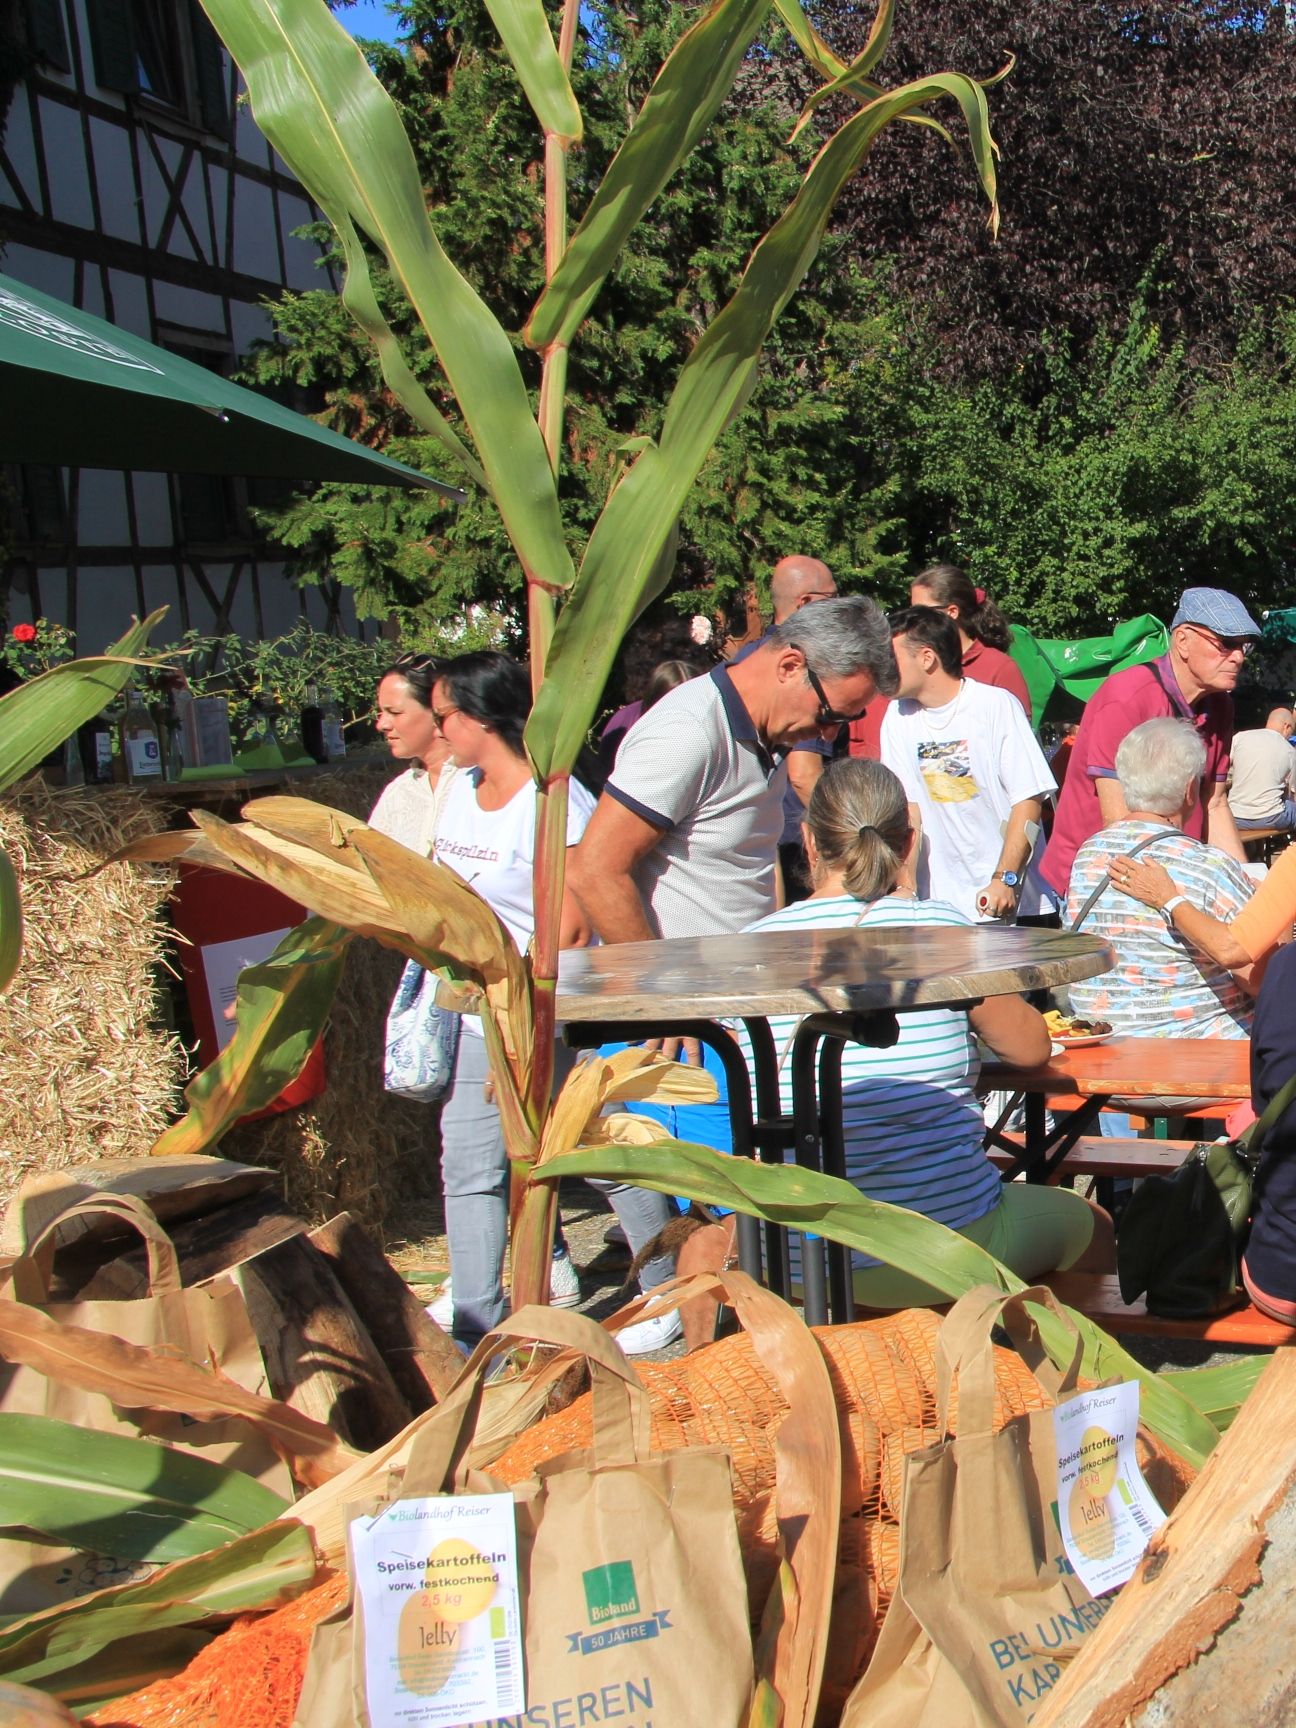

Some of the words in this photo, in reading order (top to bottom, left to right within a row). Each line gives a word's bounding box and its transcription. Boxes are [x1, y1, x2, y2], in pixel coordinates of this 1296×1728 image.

[1092, 1396, 1117, 1409] Reiser
[1058, 1433, 1124, 1469] Speisekartoffeln
[1077, 1450, 1119, 1475] festkochend
[398, 1506, 458, 1522] Biolandhof
[457, 1505, 493, 1517] Reiser
[1081, 1498, 1106, 1526] Jelly
[377, 1551, 507, 1574] Speisekartoffeln
[388, 1581, 417, 1592] vorw.
[420, 1573, 500, 1590] festkochend
[421, 1593, 441, 1608] 2,5
[444, 1593, 463, 1607] kg
[590, 1598, 638, 1622] Bioland
[418, 1620, 457, 1649] Jelly
[591, 1633, 605, 1648] 50
[607, 1624, 648, 1645] JAHRE
